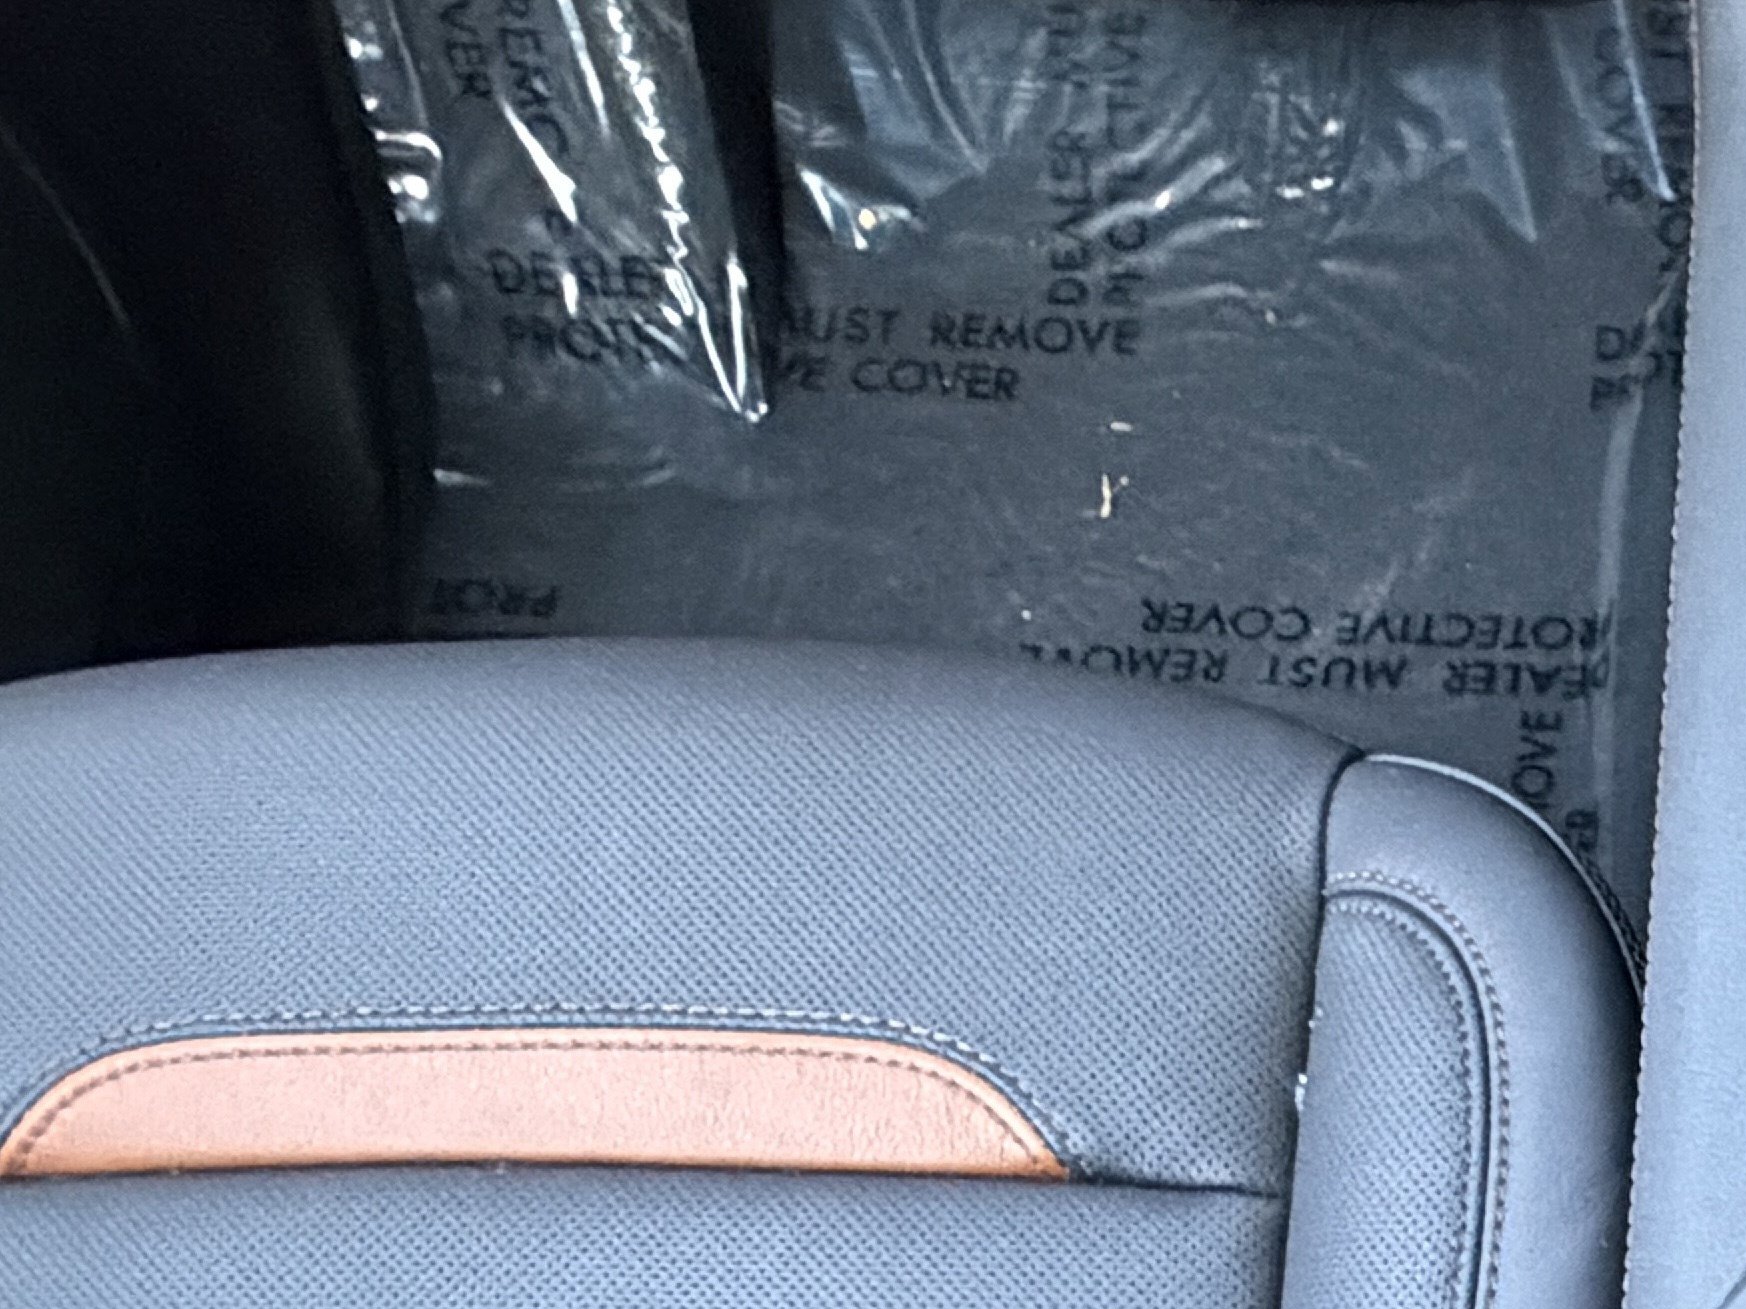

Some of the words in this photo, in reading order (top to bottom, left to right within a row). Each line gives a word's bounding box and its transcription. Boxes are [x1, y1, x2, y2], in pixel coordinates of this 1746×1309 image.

[930, 311, 1140, 357] REMOVE
[852, 357, 1020, 401] COVER
[1139, 597, 1312, 643] COVER
[1257, 654, 1409, 692] MUST
